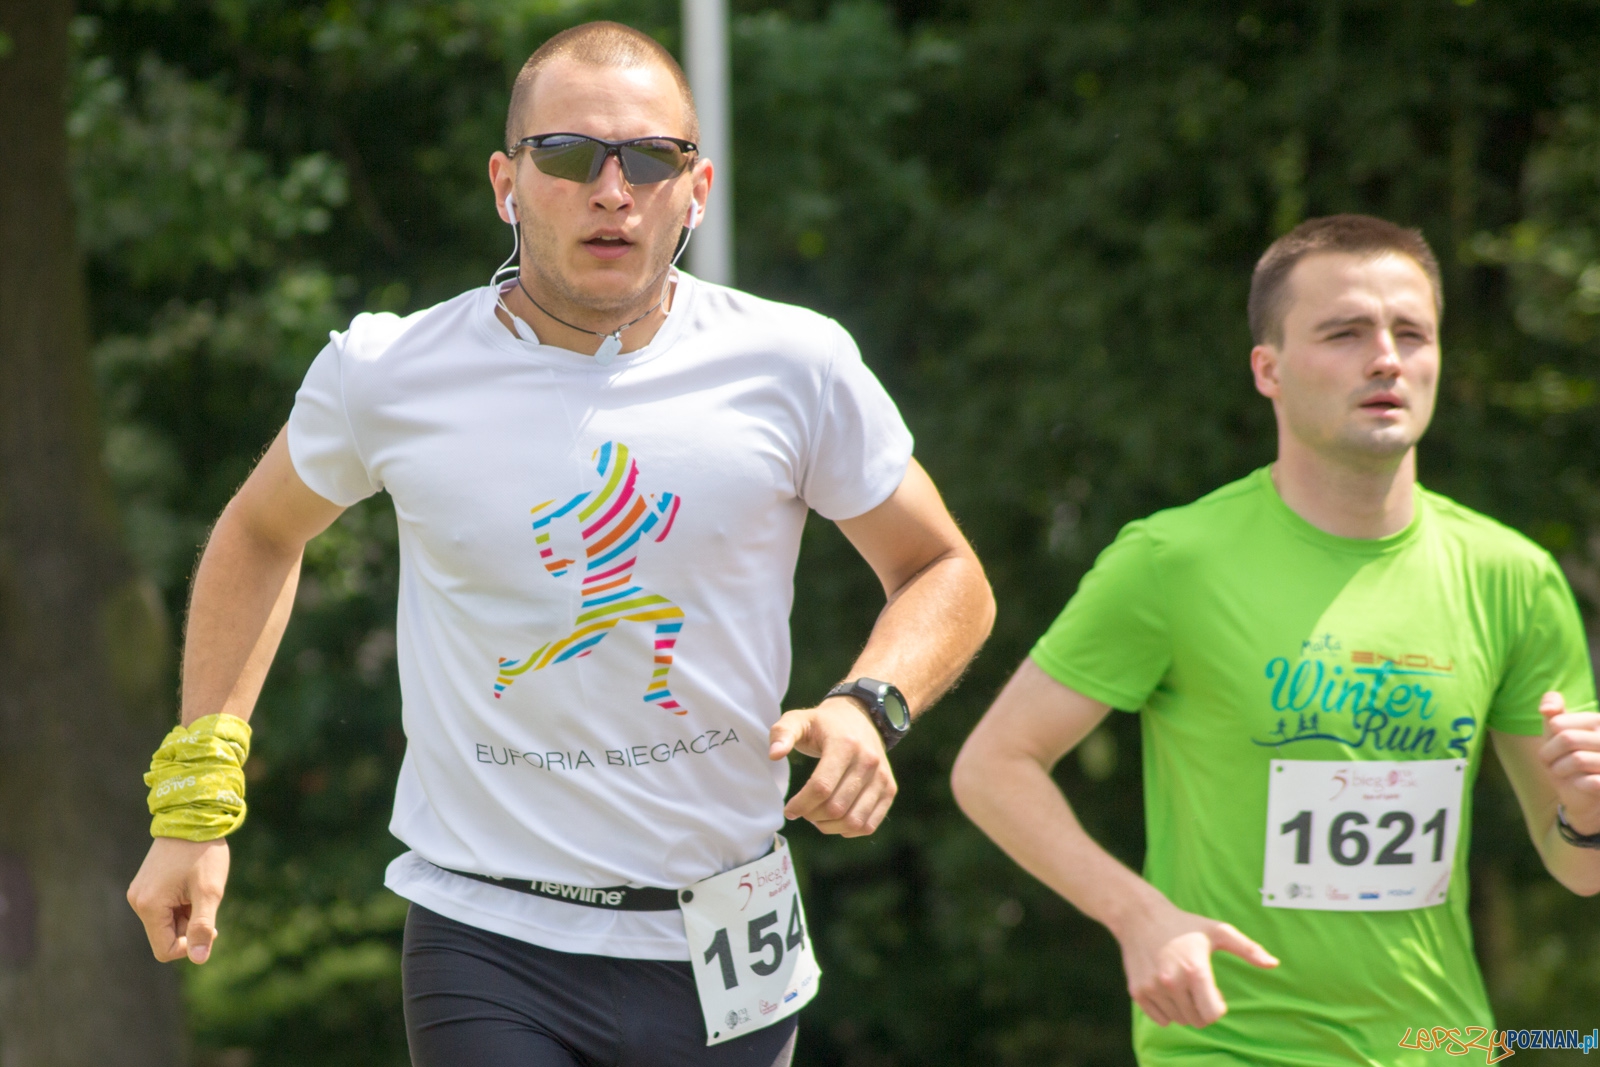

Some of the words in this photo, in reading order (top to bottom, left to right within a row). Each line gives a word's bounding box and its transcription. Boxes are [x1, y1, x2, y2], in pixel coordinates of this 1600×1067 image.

[1265, 656, 1454, 720] Winter
[475, 743, 595, 771] EUFORIA
[605, 728, 739, 768] BIEGACZA
[1352, 707, 1437, 755] Run
[156, 775, 196, 798] SALCO
[1280, 808, 1448, 867] 1621
[737, 872, 753, 911] 5
[755, 868, 783, 887] bieg
